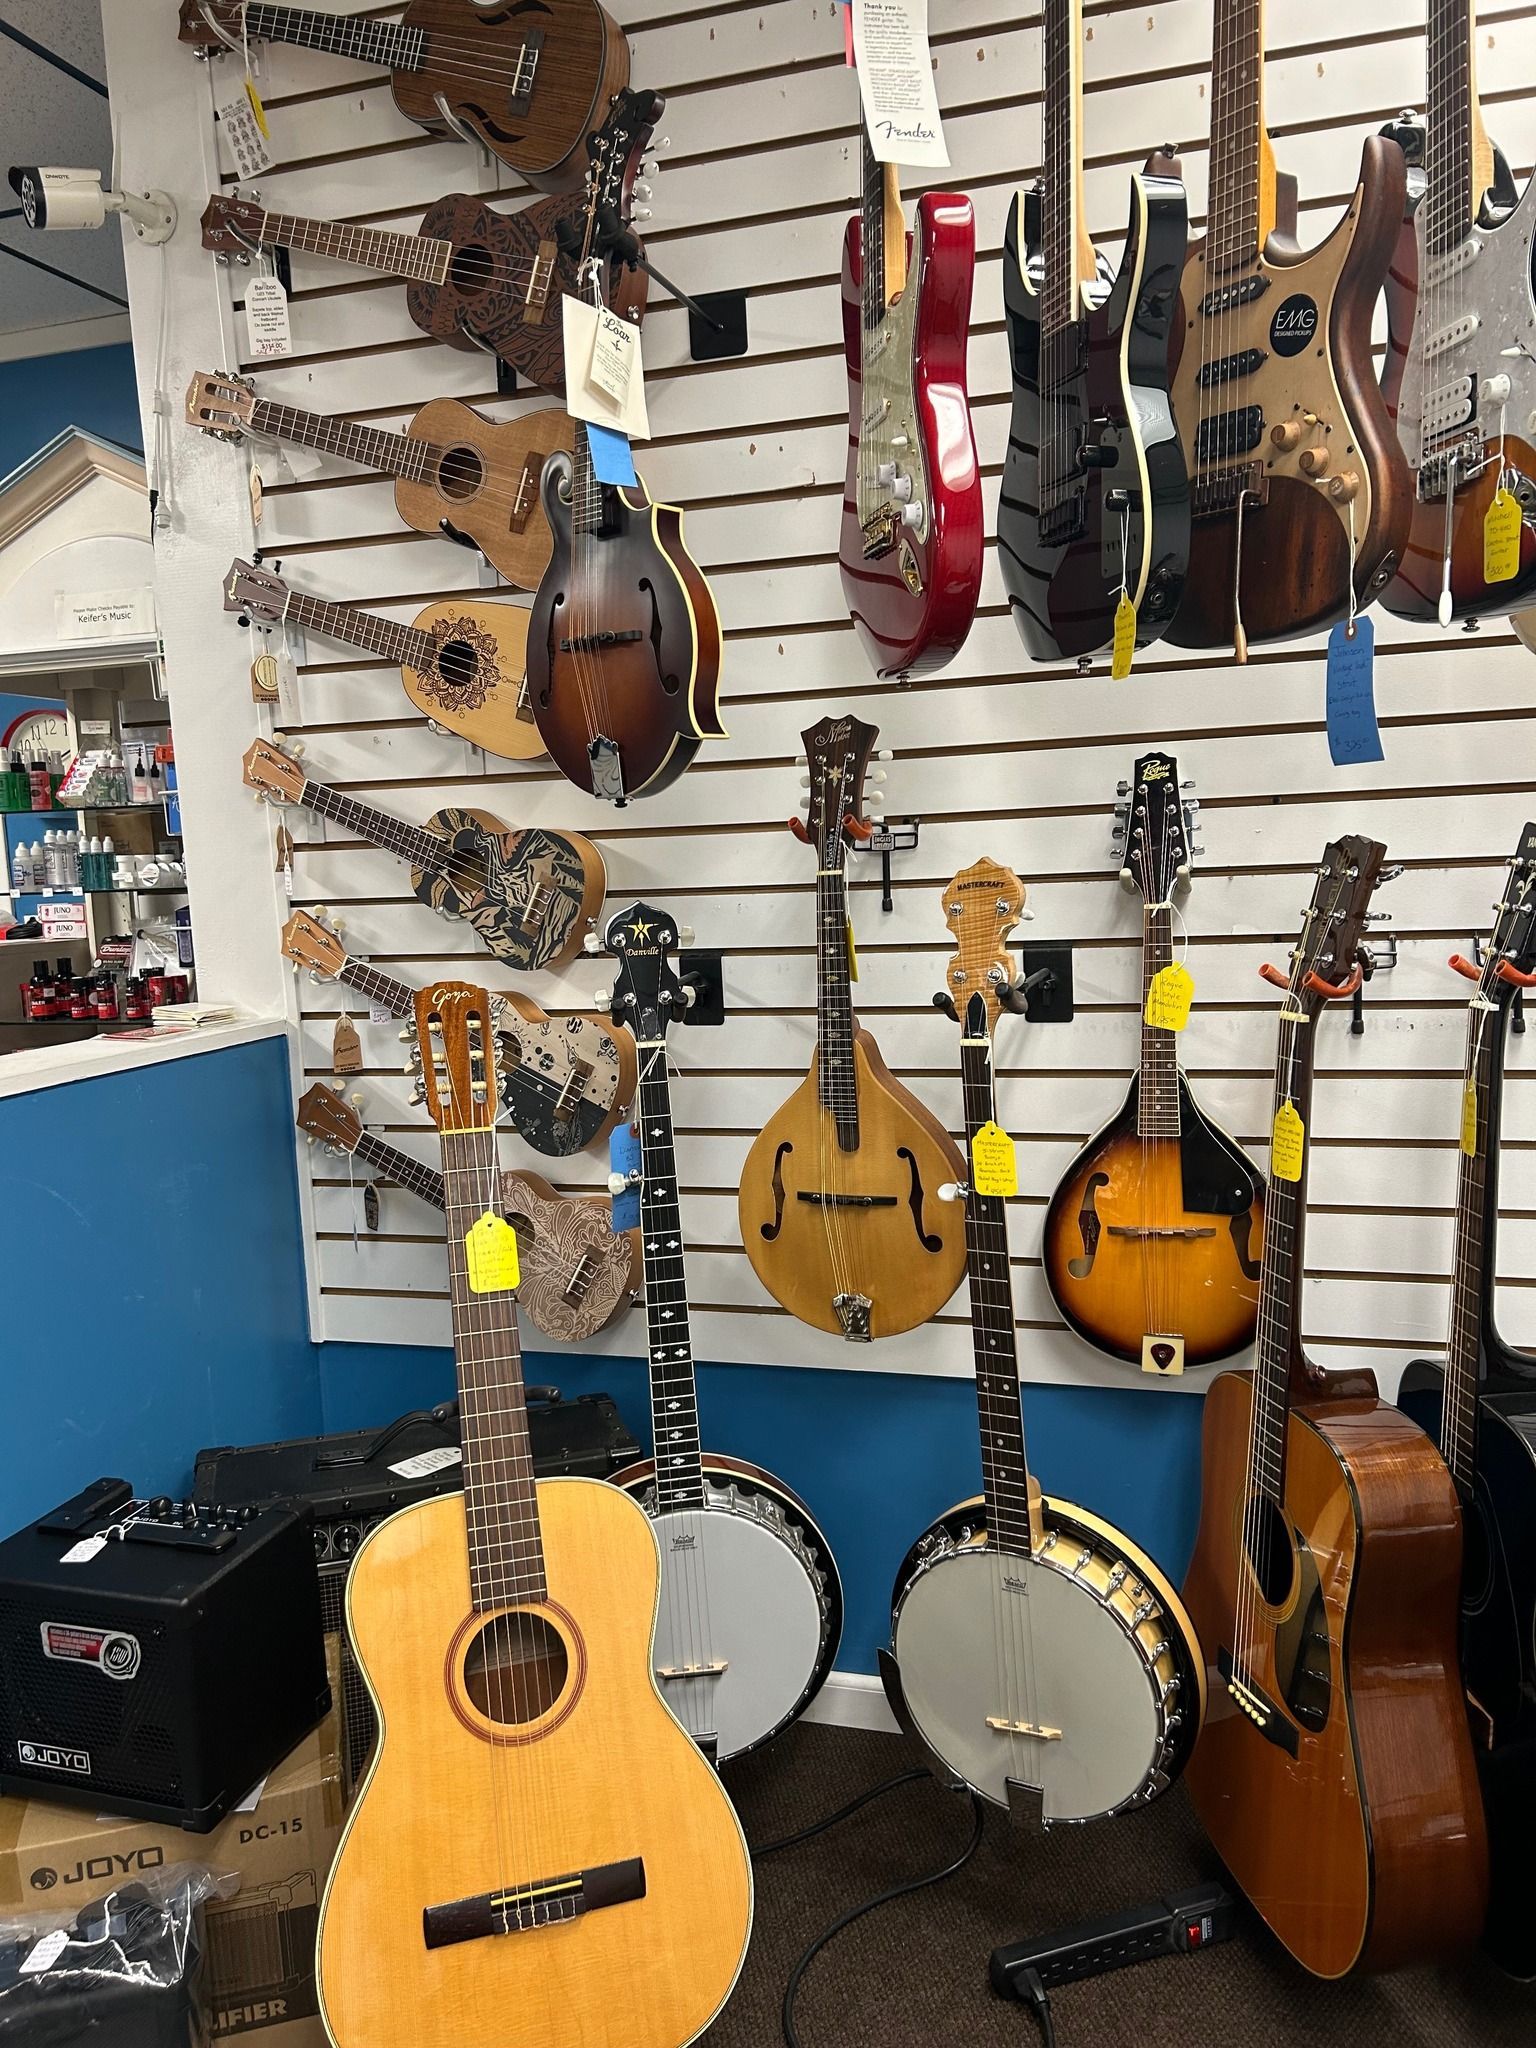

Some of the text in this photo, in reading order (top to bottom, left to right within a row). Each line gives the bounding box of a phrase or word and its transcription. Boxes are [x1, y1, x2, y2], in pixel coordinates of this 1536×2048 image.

[875, 121, 936, 139] Fender
[1275, 309, 1315, 330] EMG
[603, 317, 631, 343] Loar
[78, 612, 131, 623] Keifer's Music
[30, 725, 42, 741] 11
[44, 719, 57, 735] 12
[20, 739, 31, 754] 10
[1140, 760, 1171, 778] Rogue
[957, 880, 1005, 891] MASTERCRAFT
[625, 946, 659, 956] Danville
[1161, 978, 1183, 991] Rogue
[432, 988, 474, 1011] Goya
[38, 1749, 87, 1769] JOYO
[239, 1817, 303, 1844] DC-15
[63, 1846, 163, 1884] JOYO
